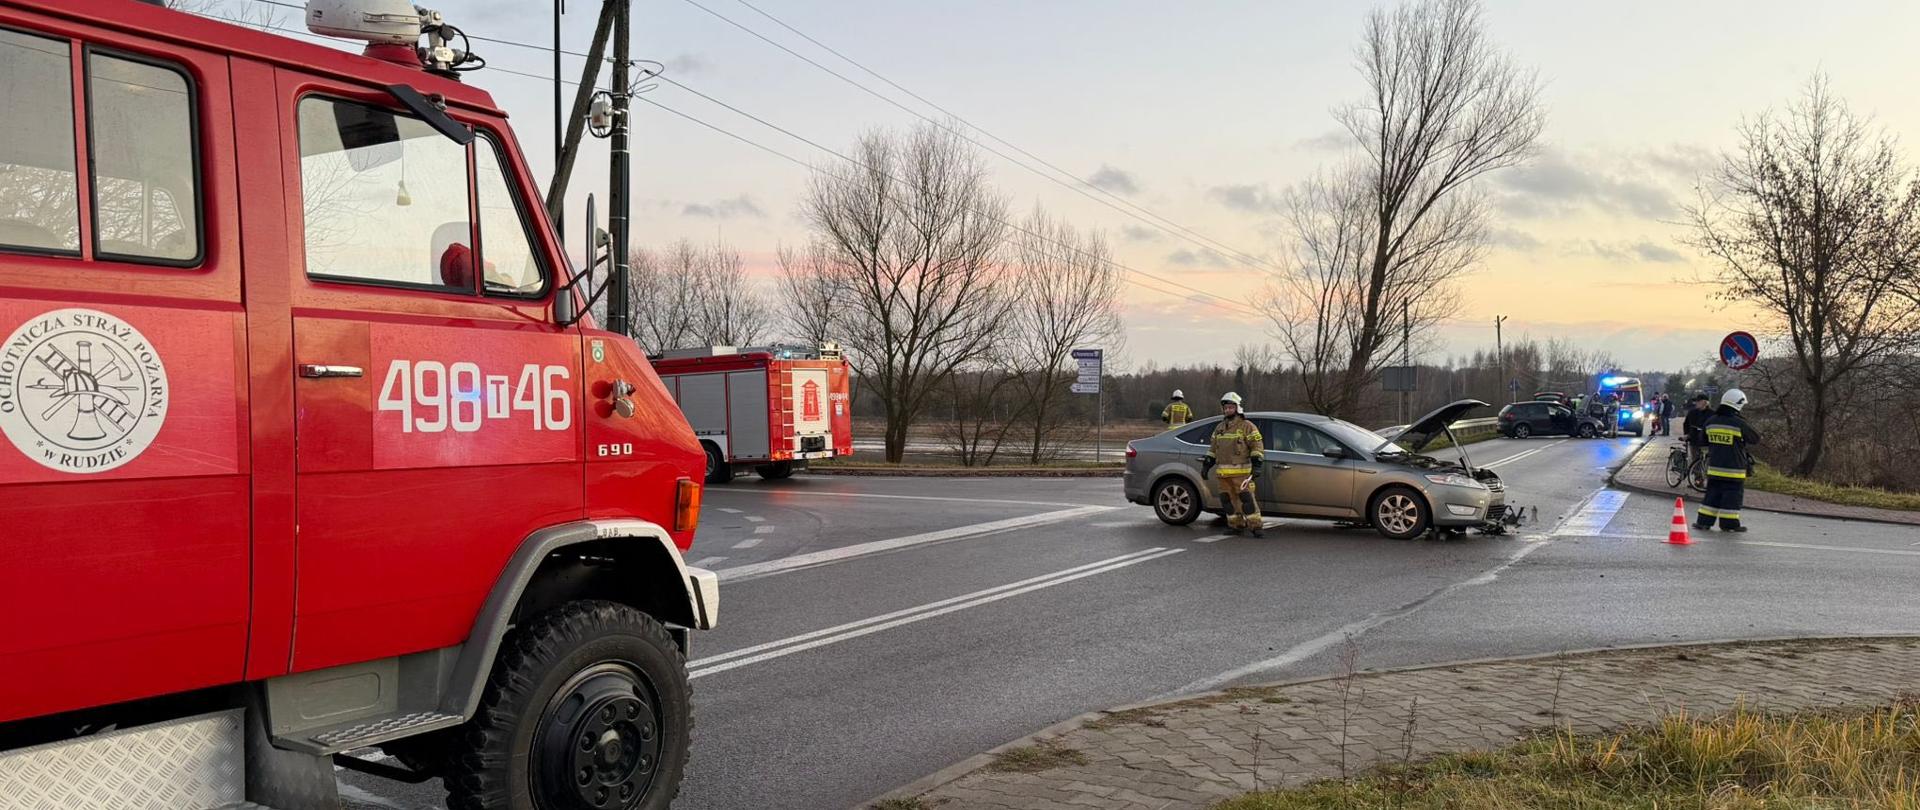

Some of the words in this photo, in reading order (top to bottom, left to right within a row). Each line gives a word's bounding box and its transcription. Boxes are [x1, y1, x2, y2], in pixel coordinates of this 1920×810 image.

[0, 317, 65, 413] OCHOTNICZA
[73, 314, 132, 342] STRAŻ
[134, 342, 163, 418] POŻARNA
[60, 446, 127, 468] RUDZIE
[598, 443, 632, 456] 690
